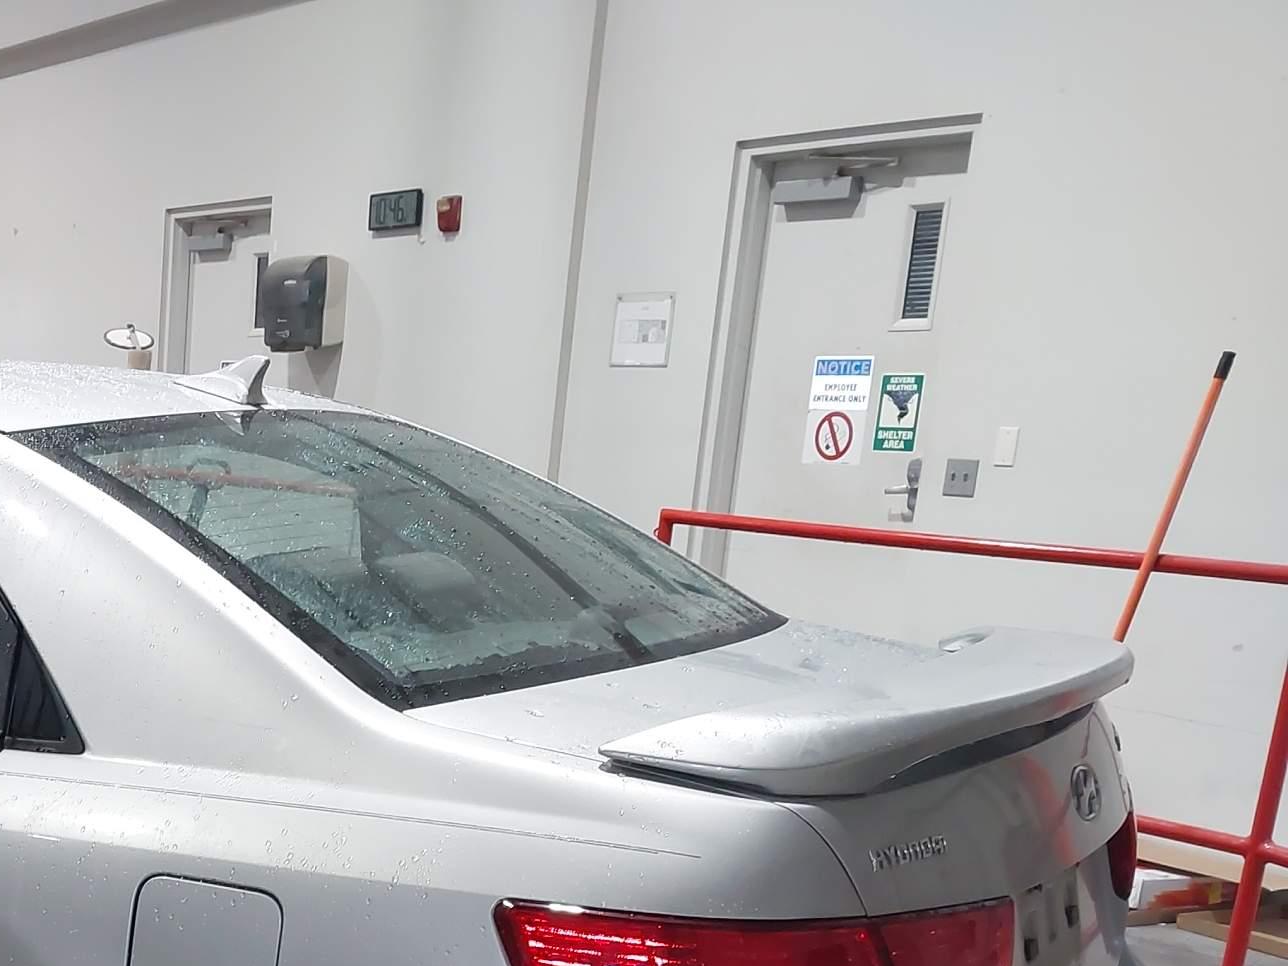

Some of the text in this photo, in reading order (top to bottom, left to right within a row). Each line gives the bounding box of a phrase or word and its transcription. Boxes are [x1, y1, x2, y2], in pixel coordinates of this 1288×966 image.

[816, 360, 871, 375] NOTICE
[824, 383, 858, 392] EMPLOYEE
[812, 394, 867, 403] ENTRANCE ONLY
[877, 430, 913, 441] SHELTER
[882, 439, 905, 450] AREA
